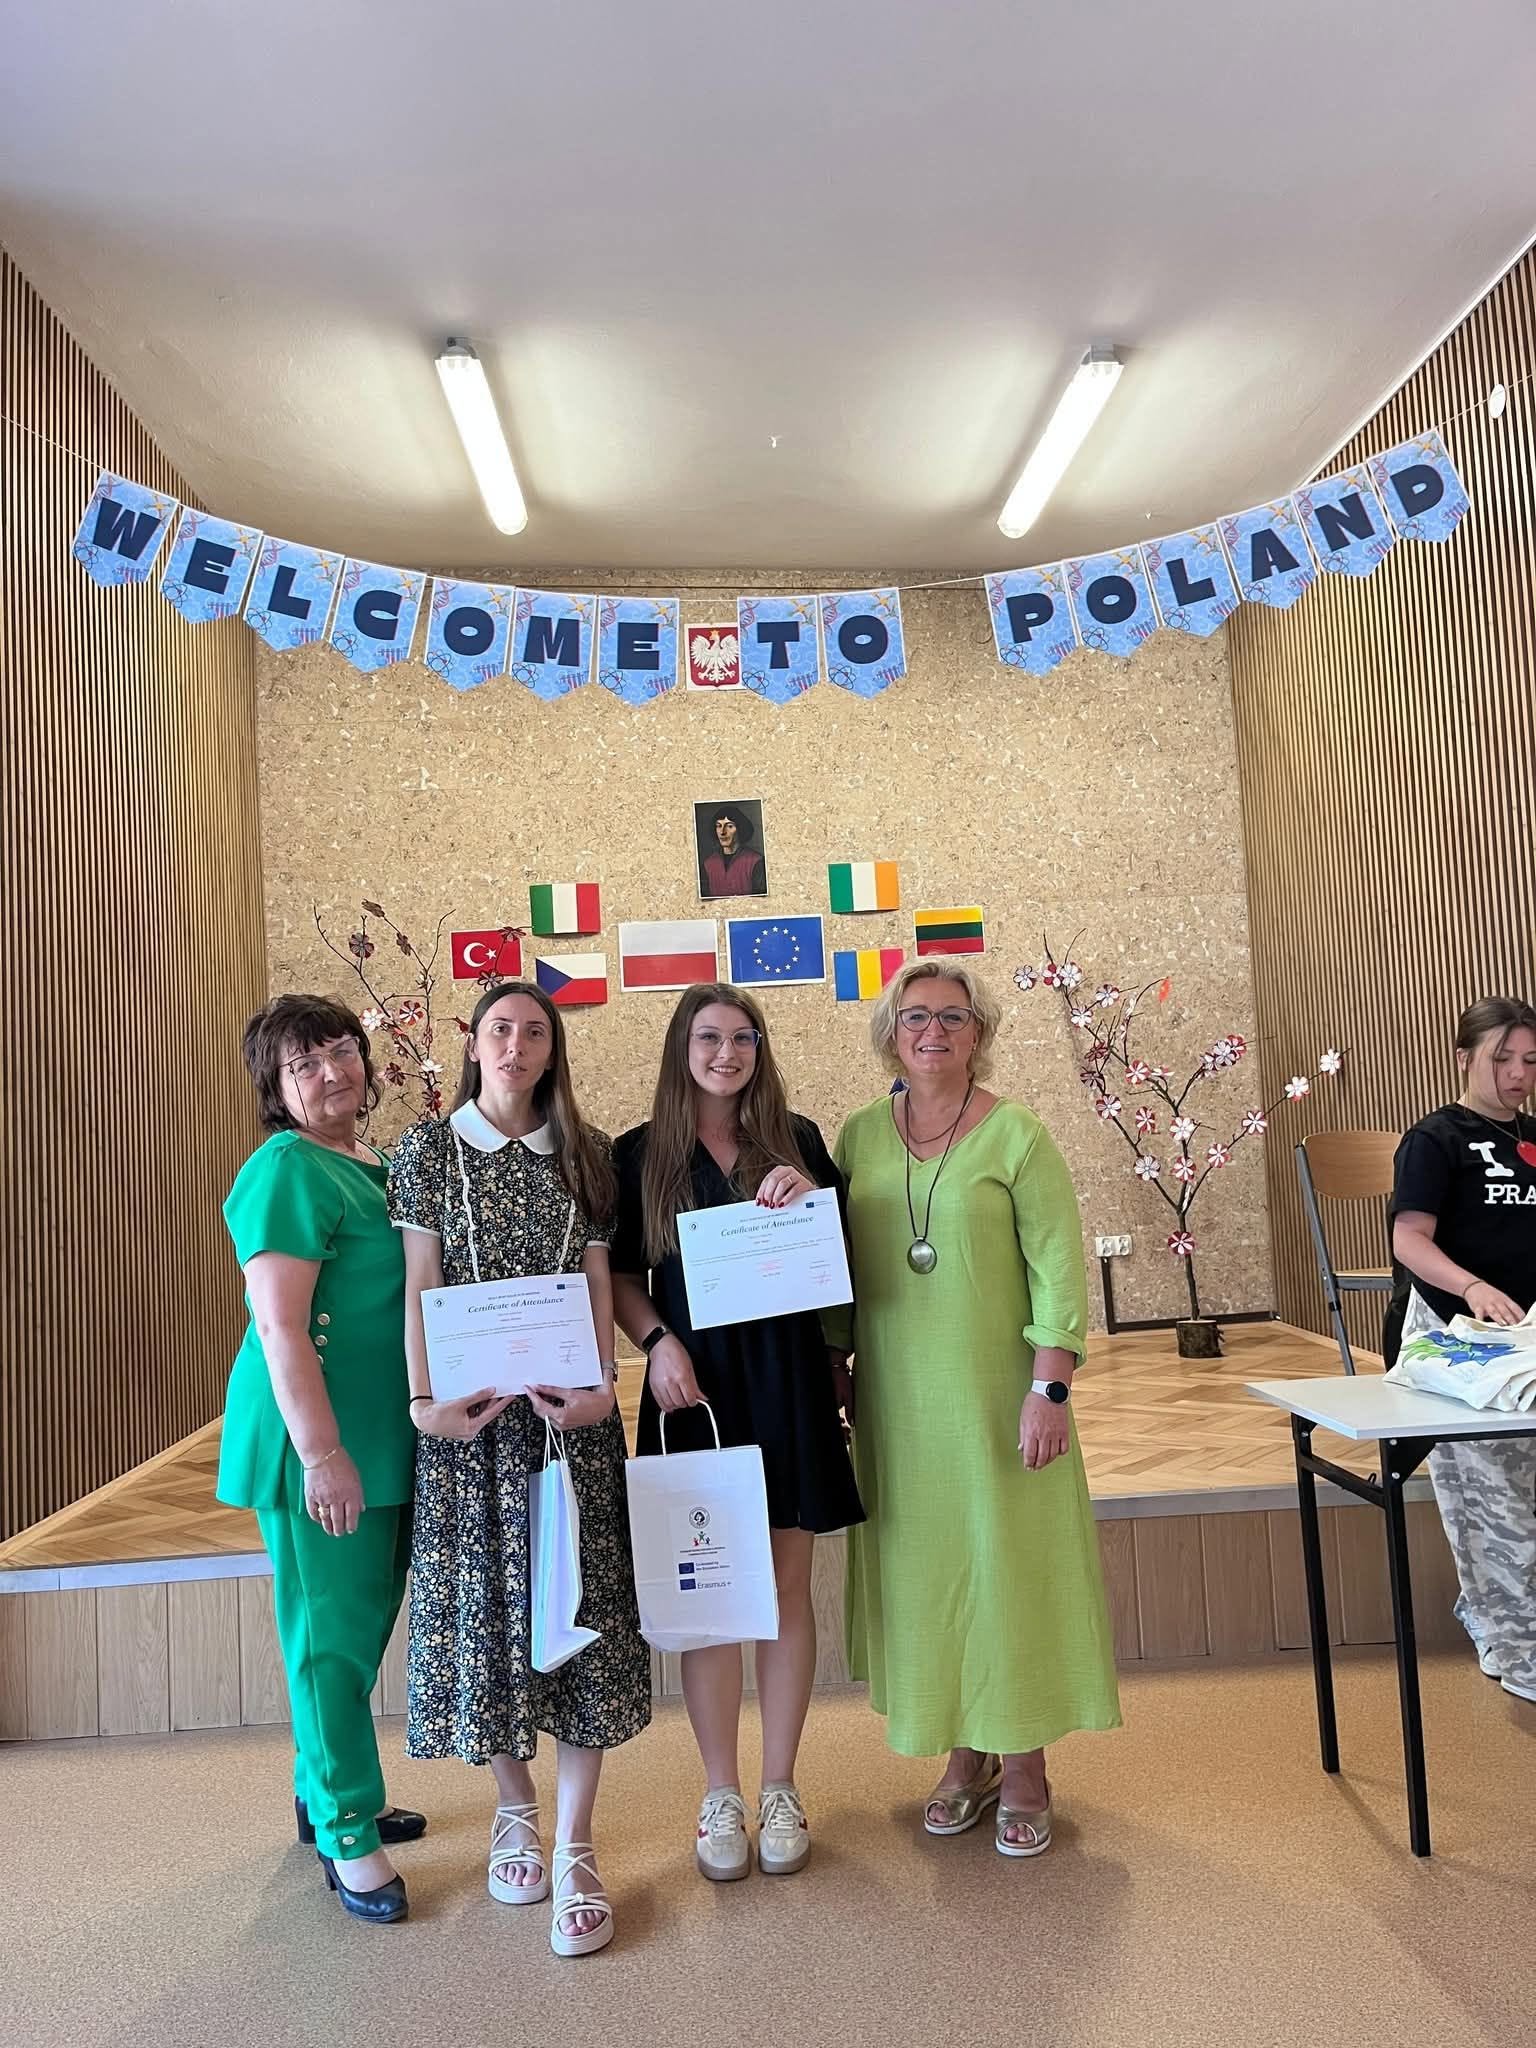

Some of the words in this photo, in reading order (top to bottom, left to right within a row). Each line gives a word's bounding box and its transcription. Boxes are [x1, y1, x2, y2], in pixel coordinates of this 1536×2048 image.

[93, 498, 662, 672] WELCOME
[755, 614, 888, 670] TO
[1006, 464, 1444, 644] POLAND
[1468, 1141, 1515, 1177] I
[721, 1225, 760, 1237] Certificate
[761, 1221, 771, 1230] of
[771, 1216, 815, 1228] Attendance
[468, 1302, 509, 1313] Certificate
[511, 1300, 520, 1308] of
[520, 1297, 565, 1307] Attendance
